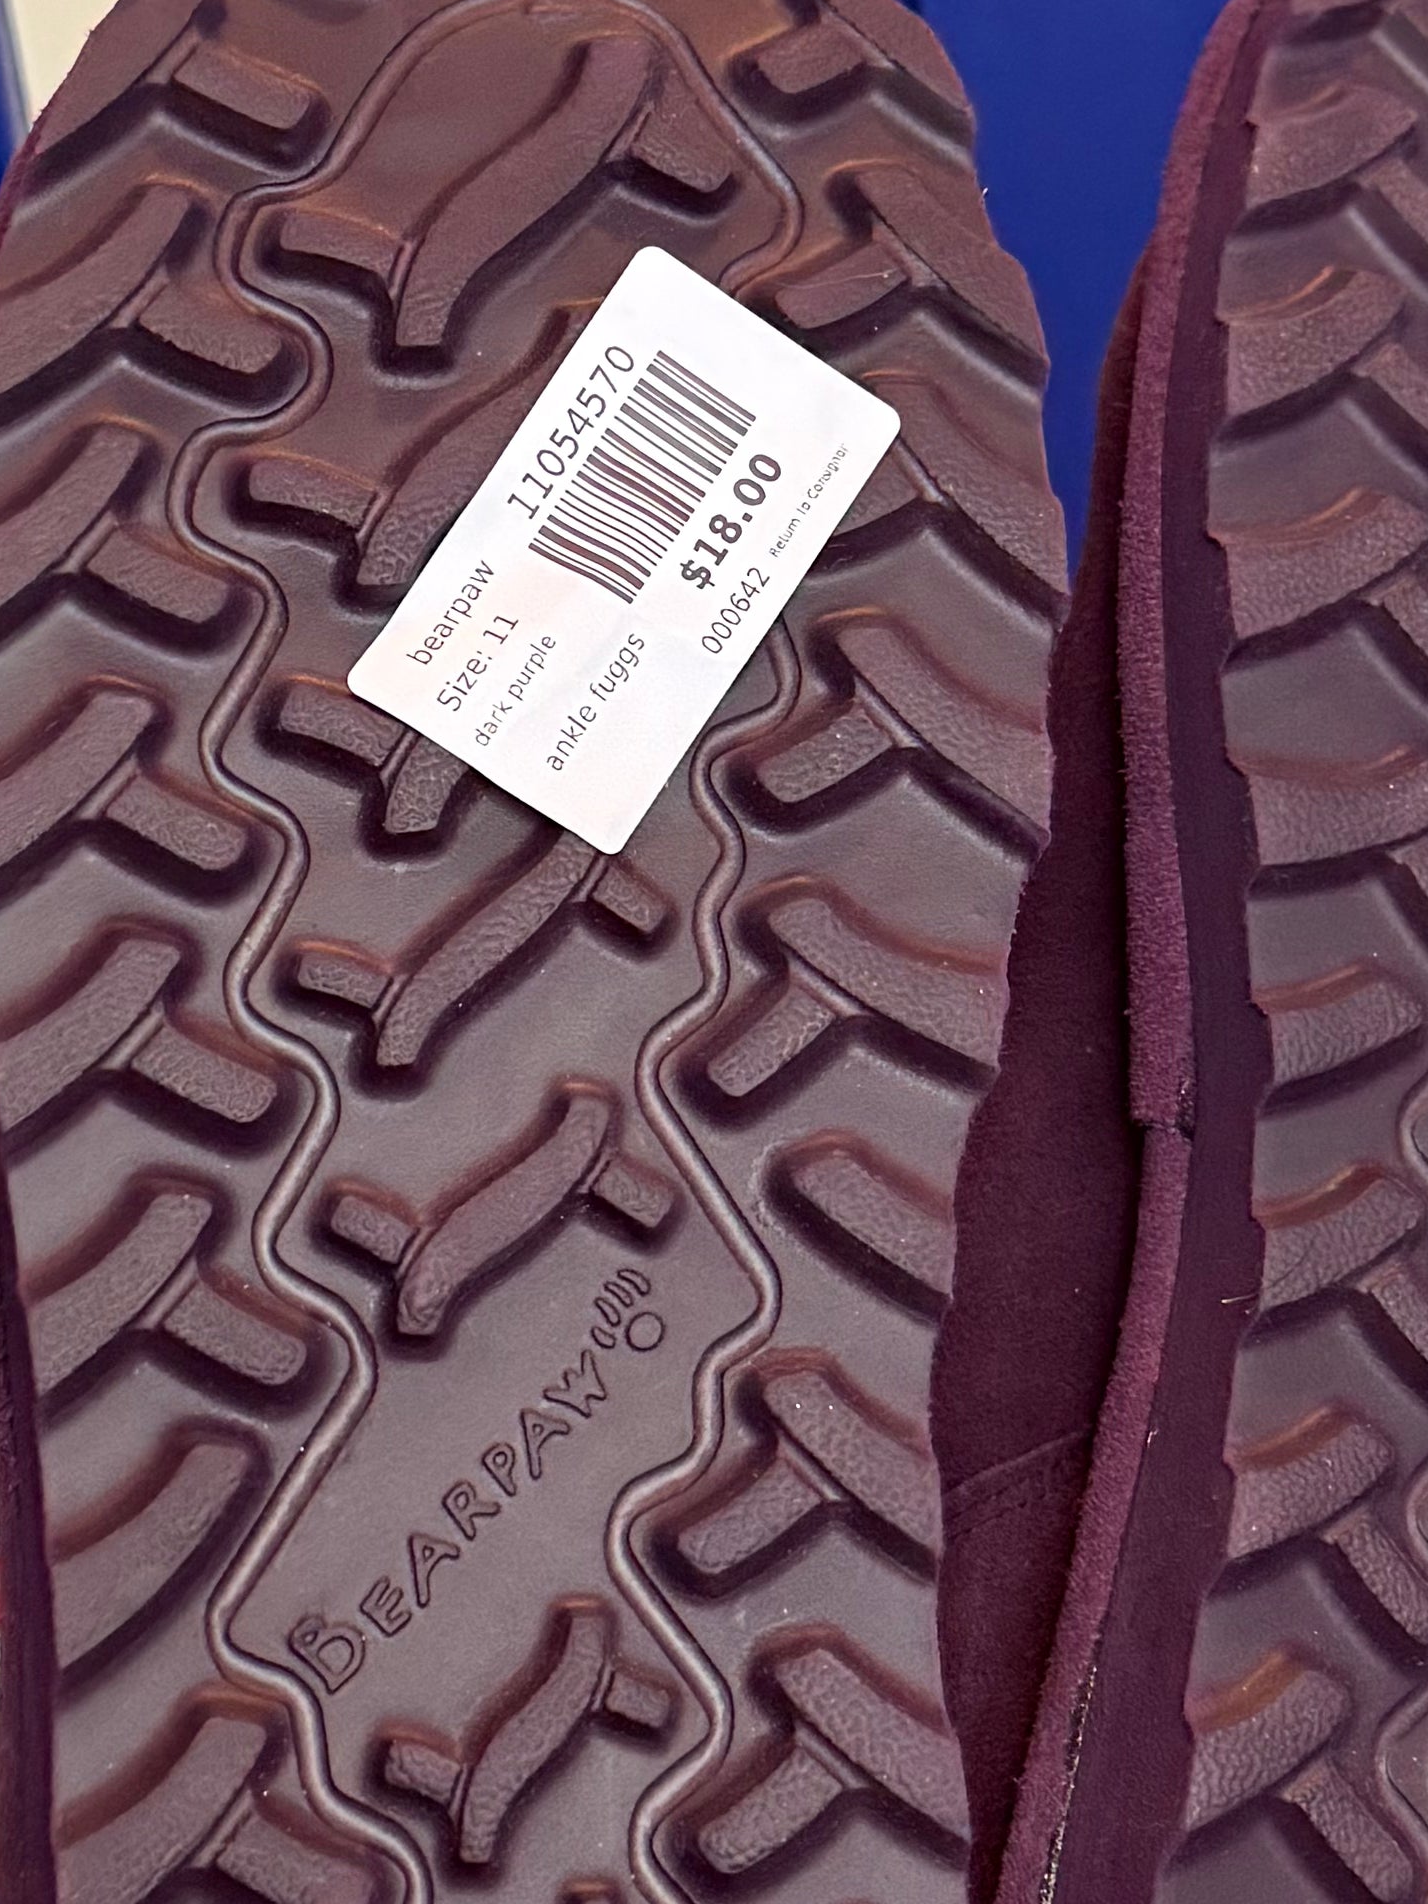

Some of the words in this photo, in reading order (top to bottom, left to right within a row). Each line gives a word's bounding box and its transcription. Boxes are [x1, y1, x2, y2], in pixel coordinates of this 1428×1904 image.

[507, 344, 635, 520] 11054570
[680, 453, 782, 590] $18.00
[406, 559, 495, 665] bearpaw
[436, 650, 493, 713] Size:
[482, 614, 519, 646] 11
[702, 566, 771, 655] 000642
[475, 700, 513, 747] dark
[507, 635, 557, 702] purple
[546, 705, 597, 772] ankle
[589, 632, 646, 702] fuggs
[286, 1348, 609, 1696] BEARPAW
